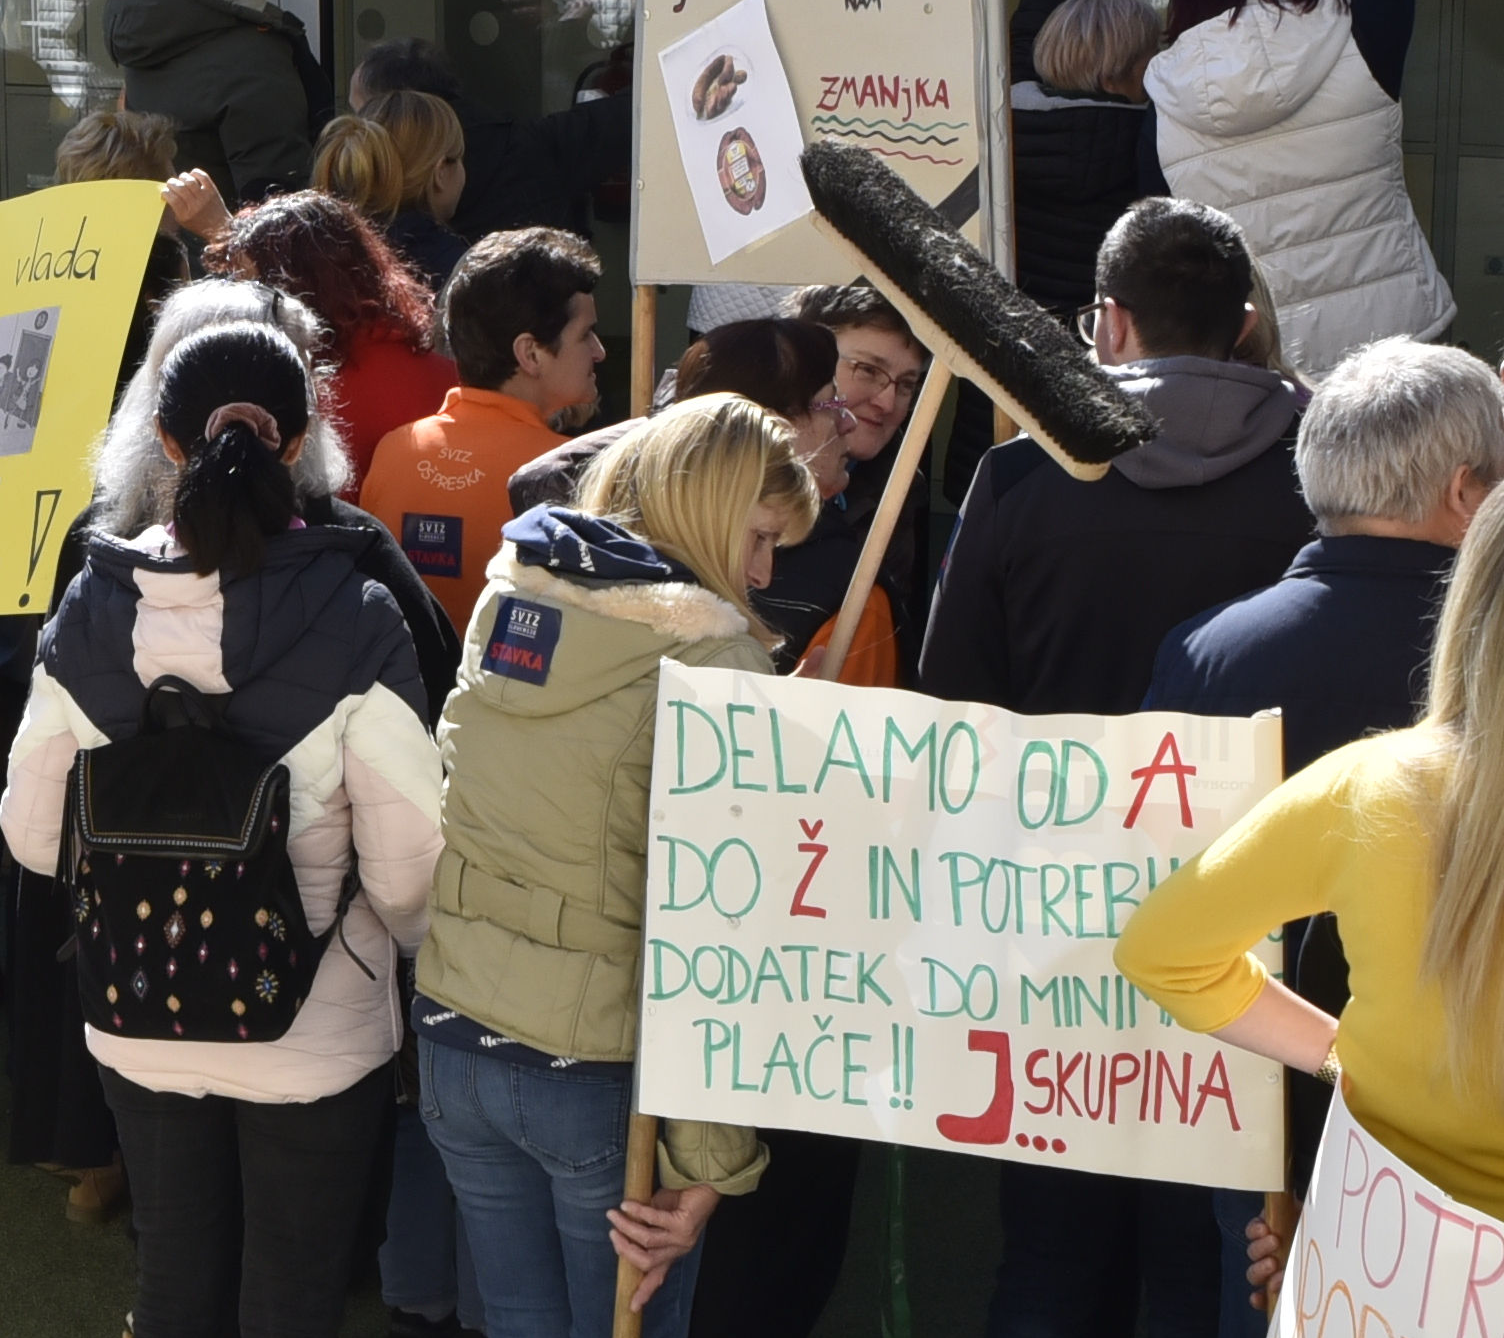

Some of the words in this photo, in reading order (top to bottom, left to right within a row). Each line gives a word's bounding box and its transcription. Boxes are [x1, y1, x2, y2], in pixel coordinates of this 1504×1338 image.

[16, 216, 101, 287] vlada
[430, 468, 486, 490] PRESKA
[438, 447, 472, 463] SVIZ
[418, 521, 446, 534] SVIZ
[510, 608, 541, 627] SVIZ
[490, 642, 543, 672] STAVKA
[666, 699, 981, 815] DELAMO
[1017, 739, 1109, 830] OD
[1123, 731, 1196, 829] A
[657, 834, 762, 919] DO
[789, 818, 829, 919] Ž
[868, 844, 922, 923] IN
[648, 939, 893, 1007] DODATEK
[918, 956, 999, 1021] DO
[693, 1015, 914, 1110] PLAČE!!
[1023, 1048, 1241, 1131] SKUPINA
